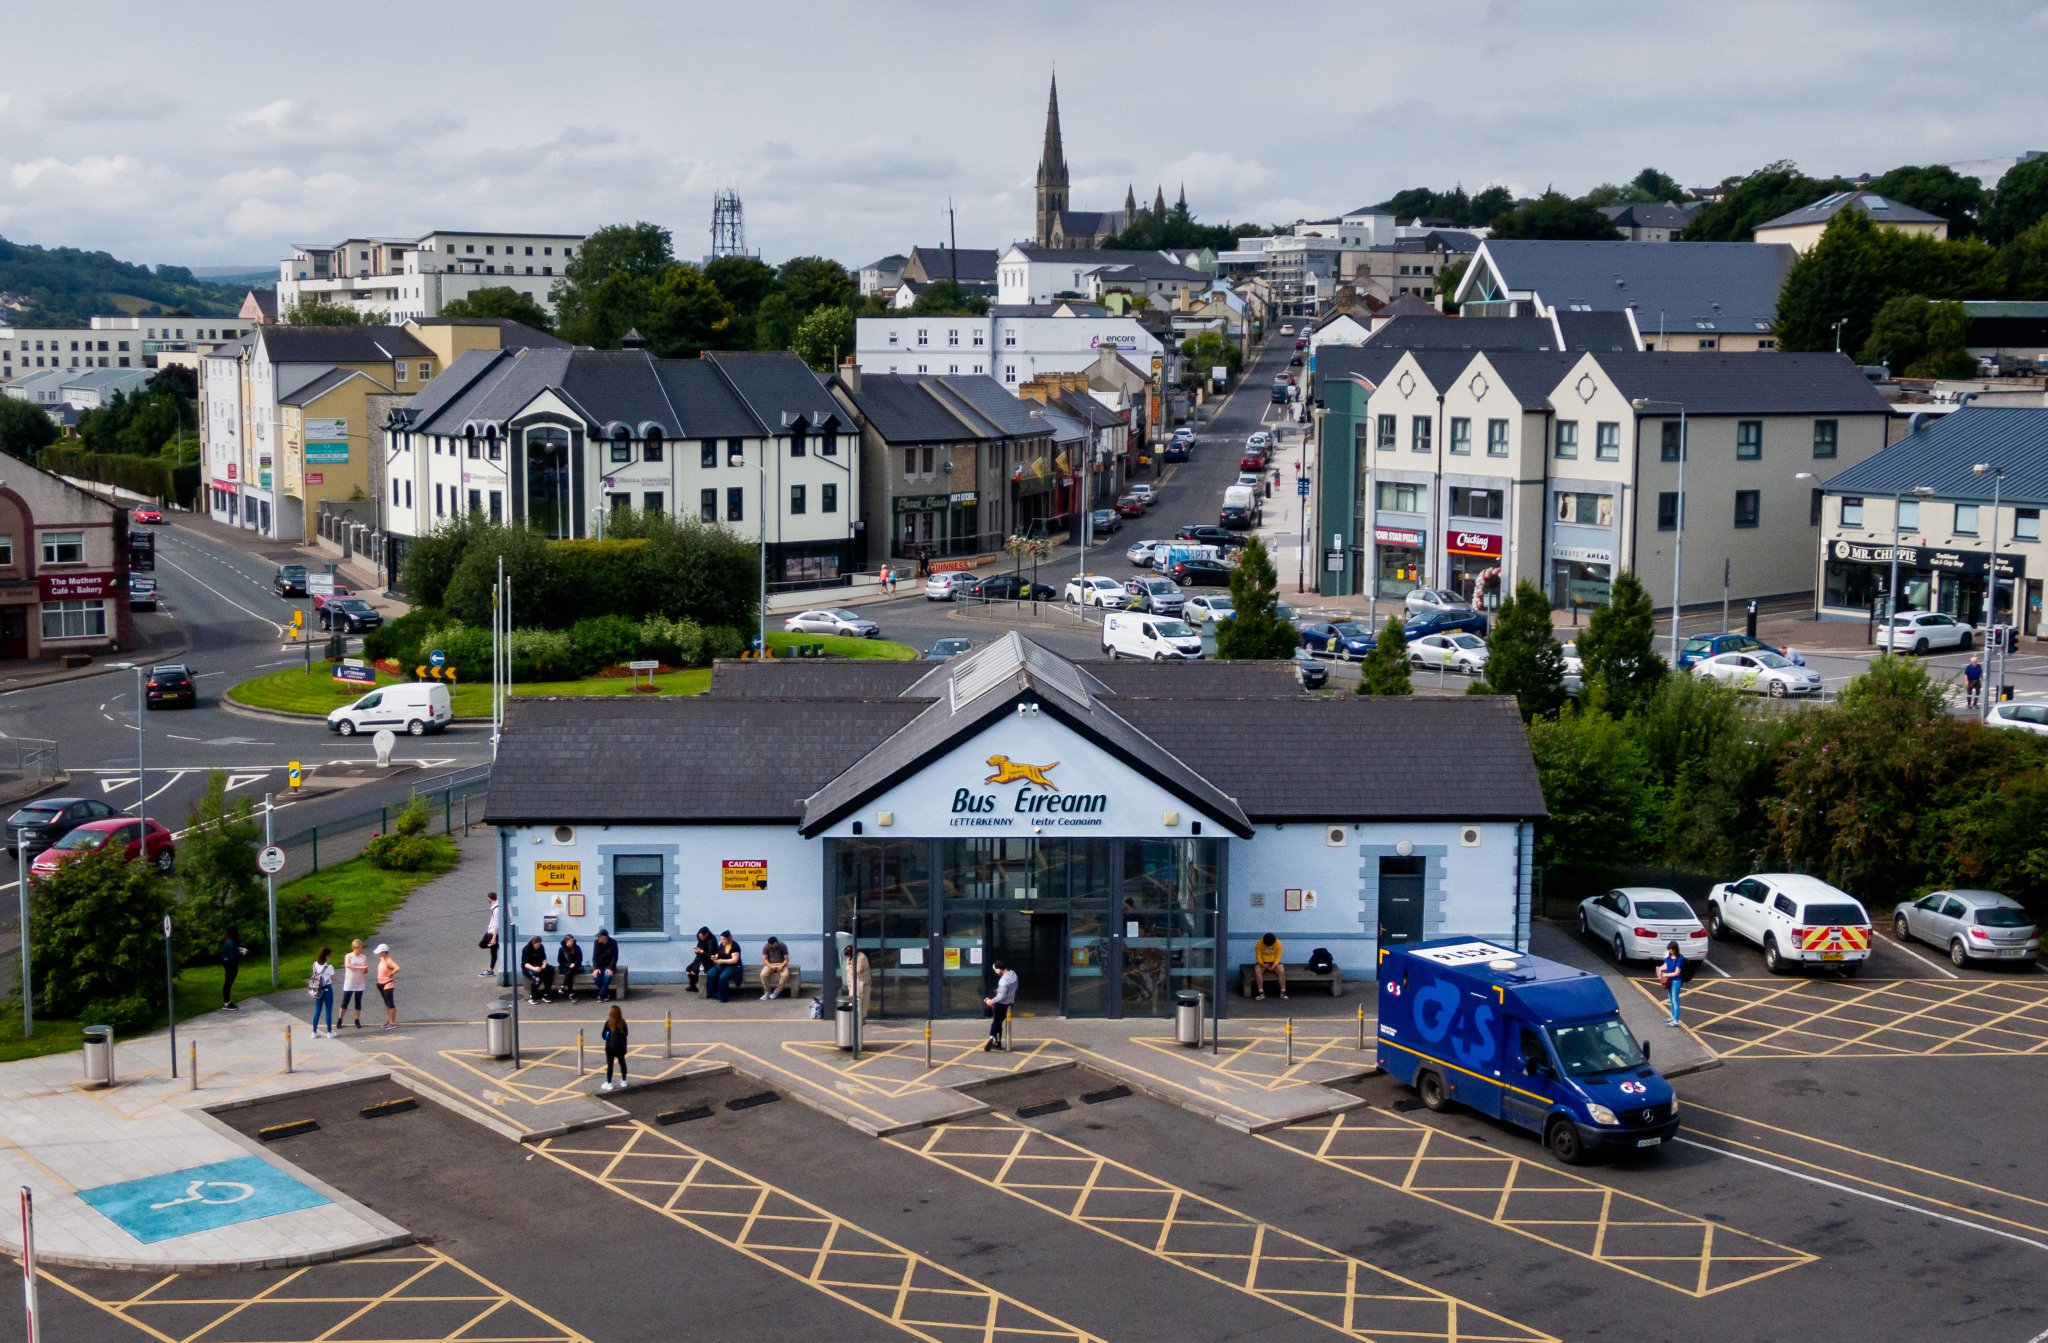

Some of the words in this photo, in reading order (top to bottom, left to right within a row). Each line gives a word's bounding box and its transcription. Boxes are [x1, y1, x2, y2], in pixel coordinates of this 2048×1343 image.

[1389, 531, 1403, 542] STAR
[1403, 533, 1418, 544] PIZZA
[1587, 552, 1610, 560] AHEAD
[1852, 548, 1871, 559] MR.
[1874, 549, 1917, 562] CHIPIE
[929, 561, 968, 572] GUINNESS
[68, 576, 102, 584] Mothers
[77, 585, 103, 595] Bakery
[951, 787, 996, 813] Bus
[1014, 781, 1107, 813] Éireann
[949, 818, 1014, 826] LETTERKENNY
[1031, 817, 1056, 826] Leitir
[1058, 817, 1102, 826] Ceanainn
[536, 862, 579, 871] Pedestrian
[728, 860, 762, 868] CAUTION
[550, 872, 565, 880] Exit
[1413, 978, 1495, 1069] G4S
